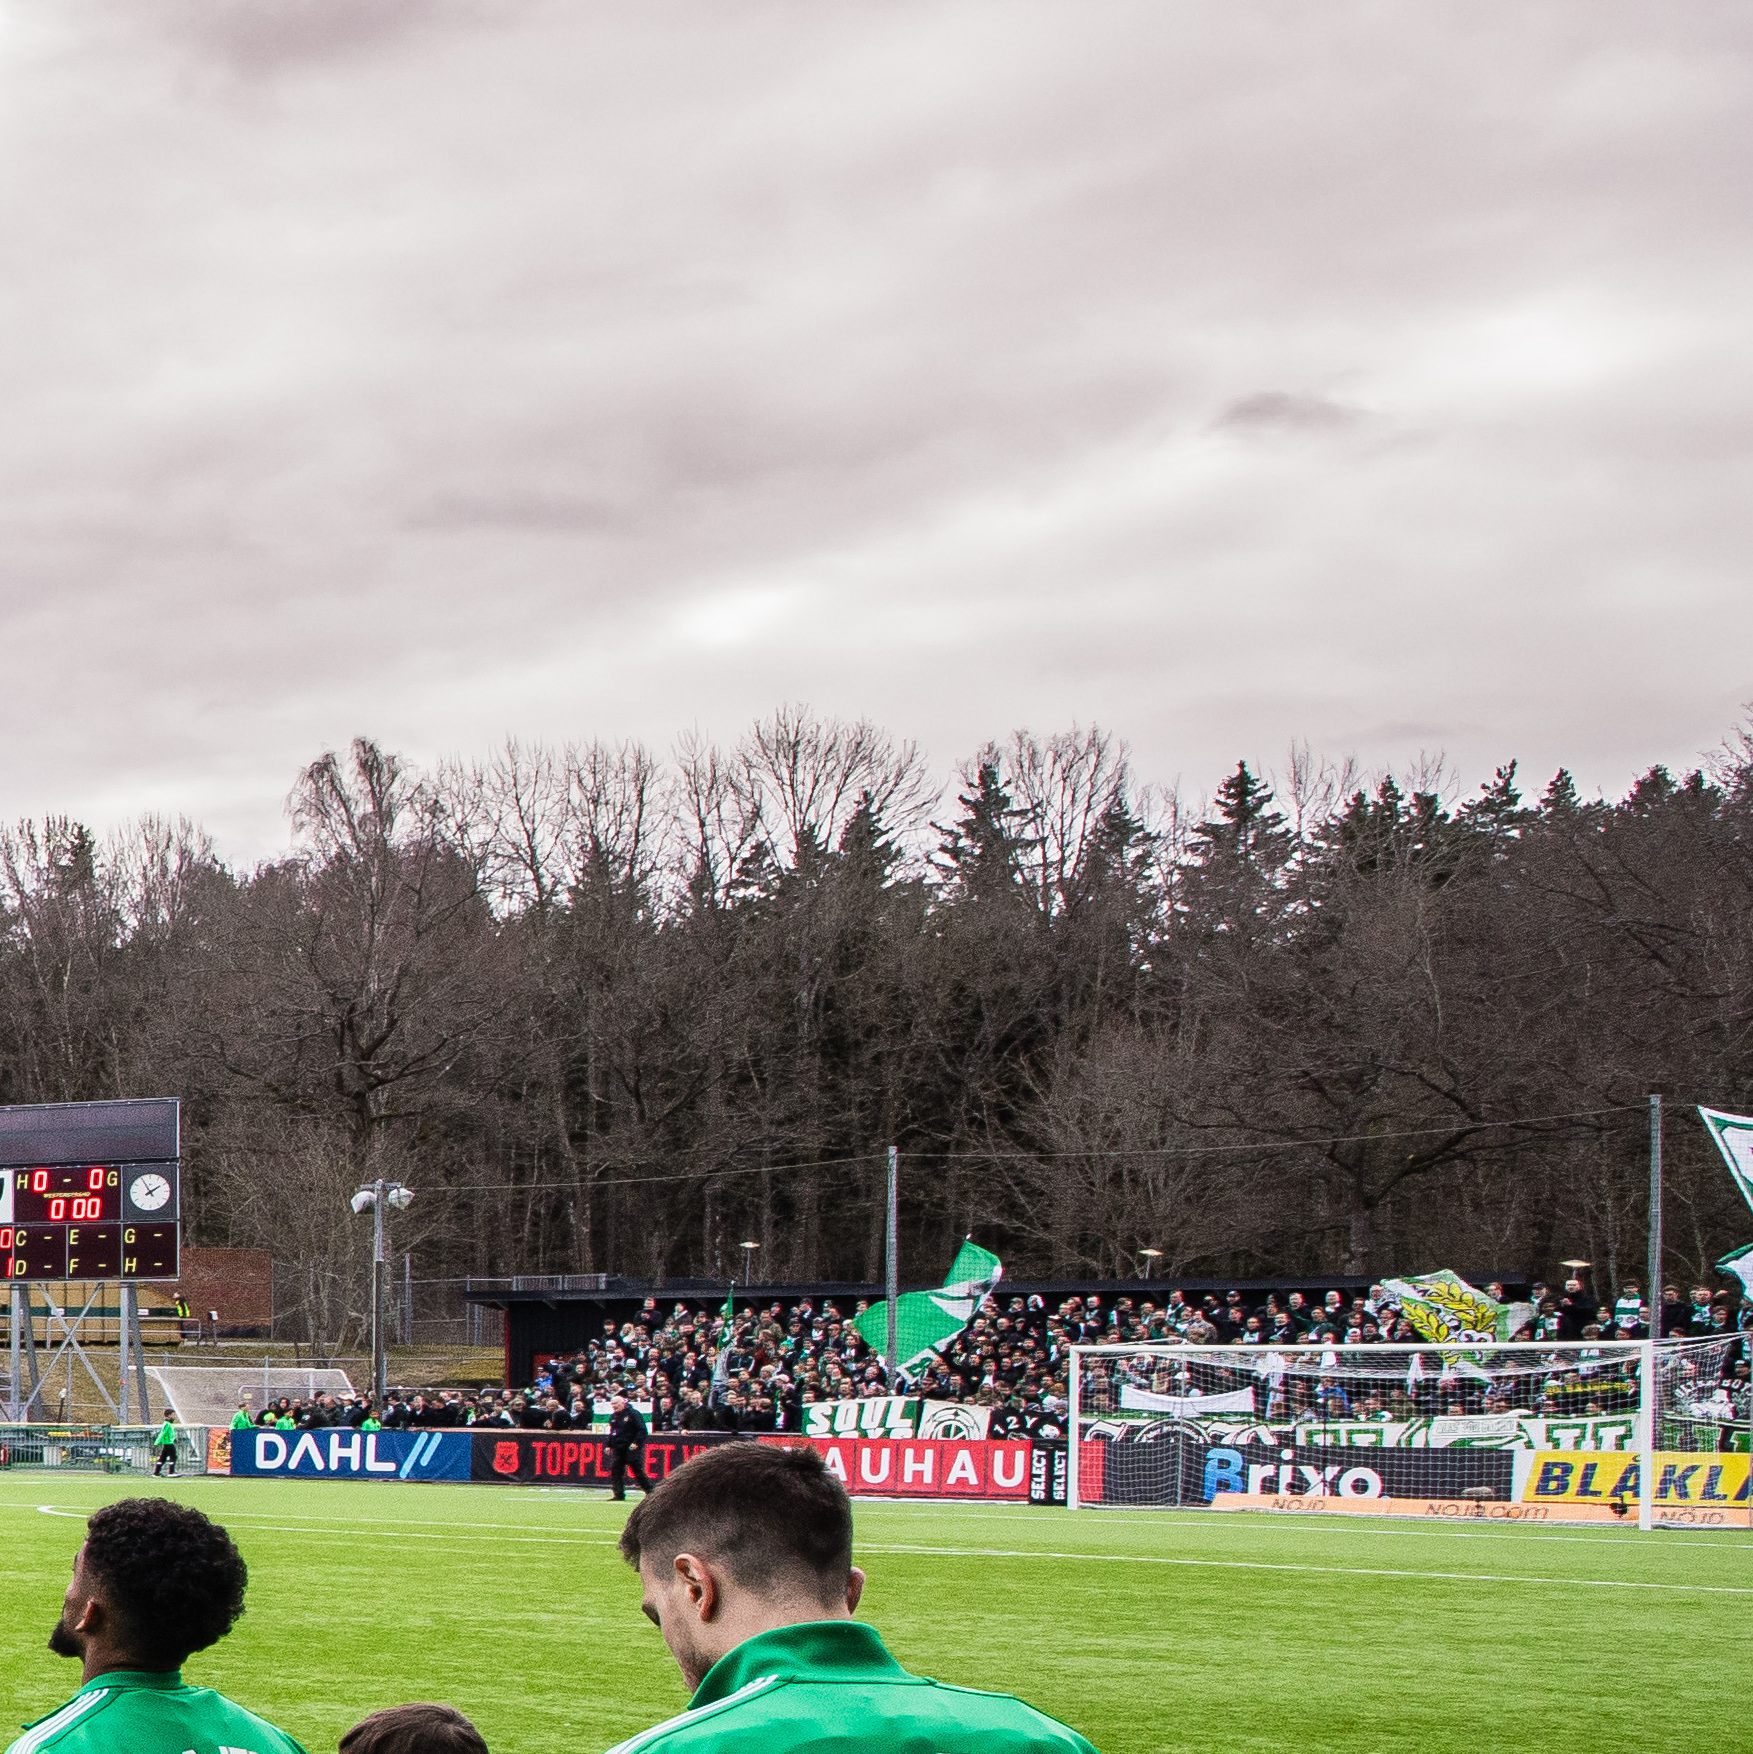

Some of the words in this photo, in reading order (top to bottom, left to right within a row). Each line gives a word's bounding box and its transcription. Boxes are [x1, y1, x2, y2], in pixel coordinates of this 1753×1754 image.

[16, 1174, 28, 1190] H
[107, 1171, 118, 1187] G
[16, 1230, 27, 1246] C
[69, 1229, 80, 1245] E
[124, 1228, 136, 1244] G
[15, 1260, 27, 1275] D
[69, 1258, 80, 1274] F
[125, 1257, 137, 1273] H
[805, 1399, 914, 1434] SOUL
[254, 1430, 397, 1472] DAHL
[1030, 1448, 1047, 1500] SELECT
